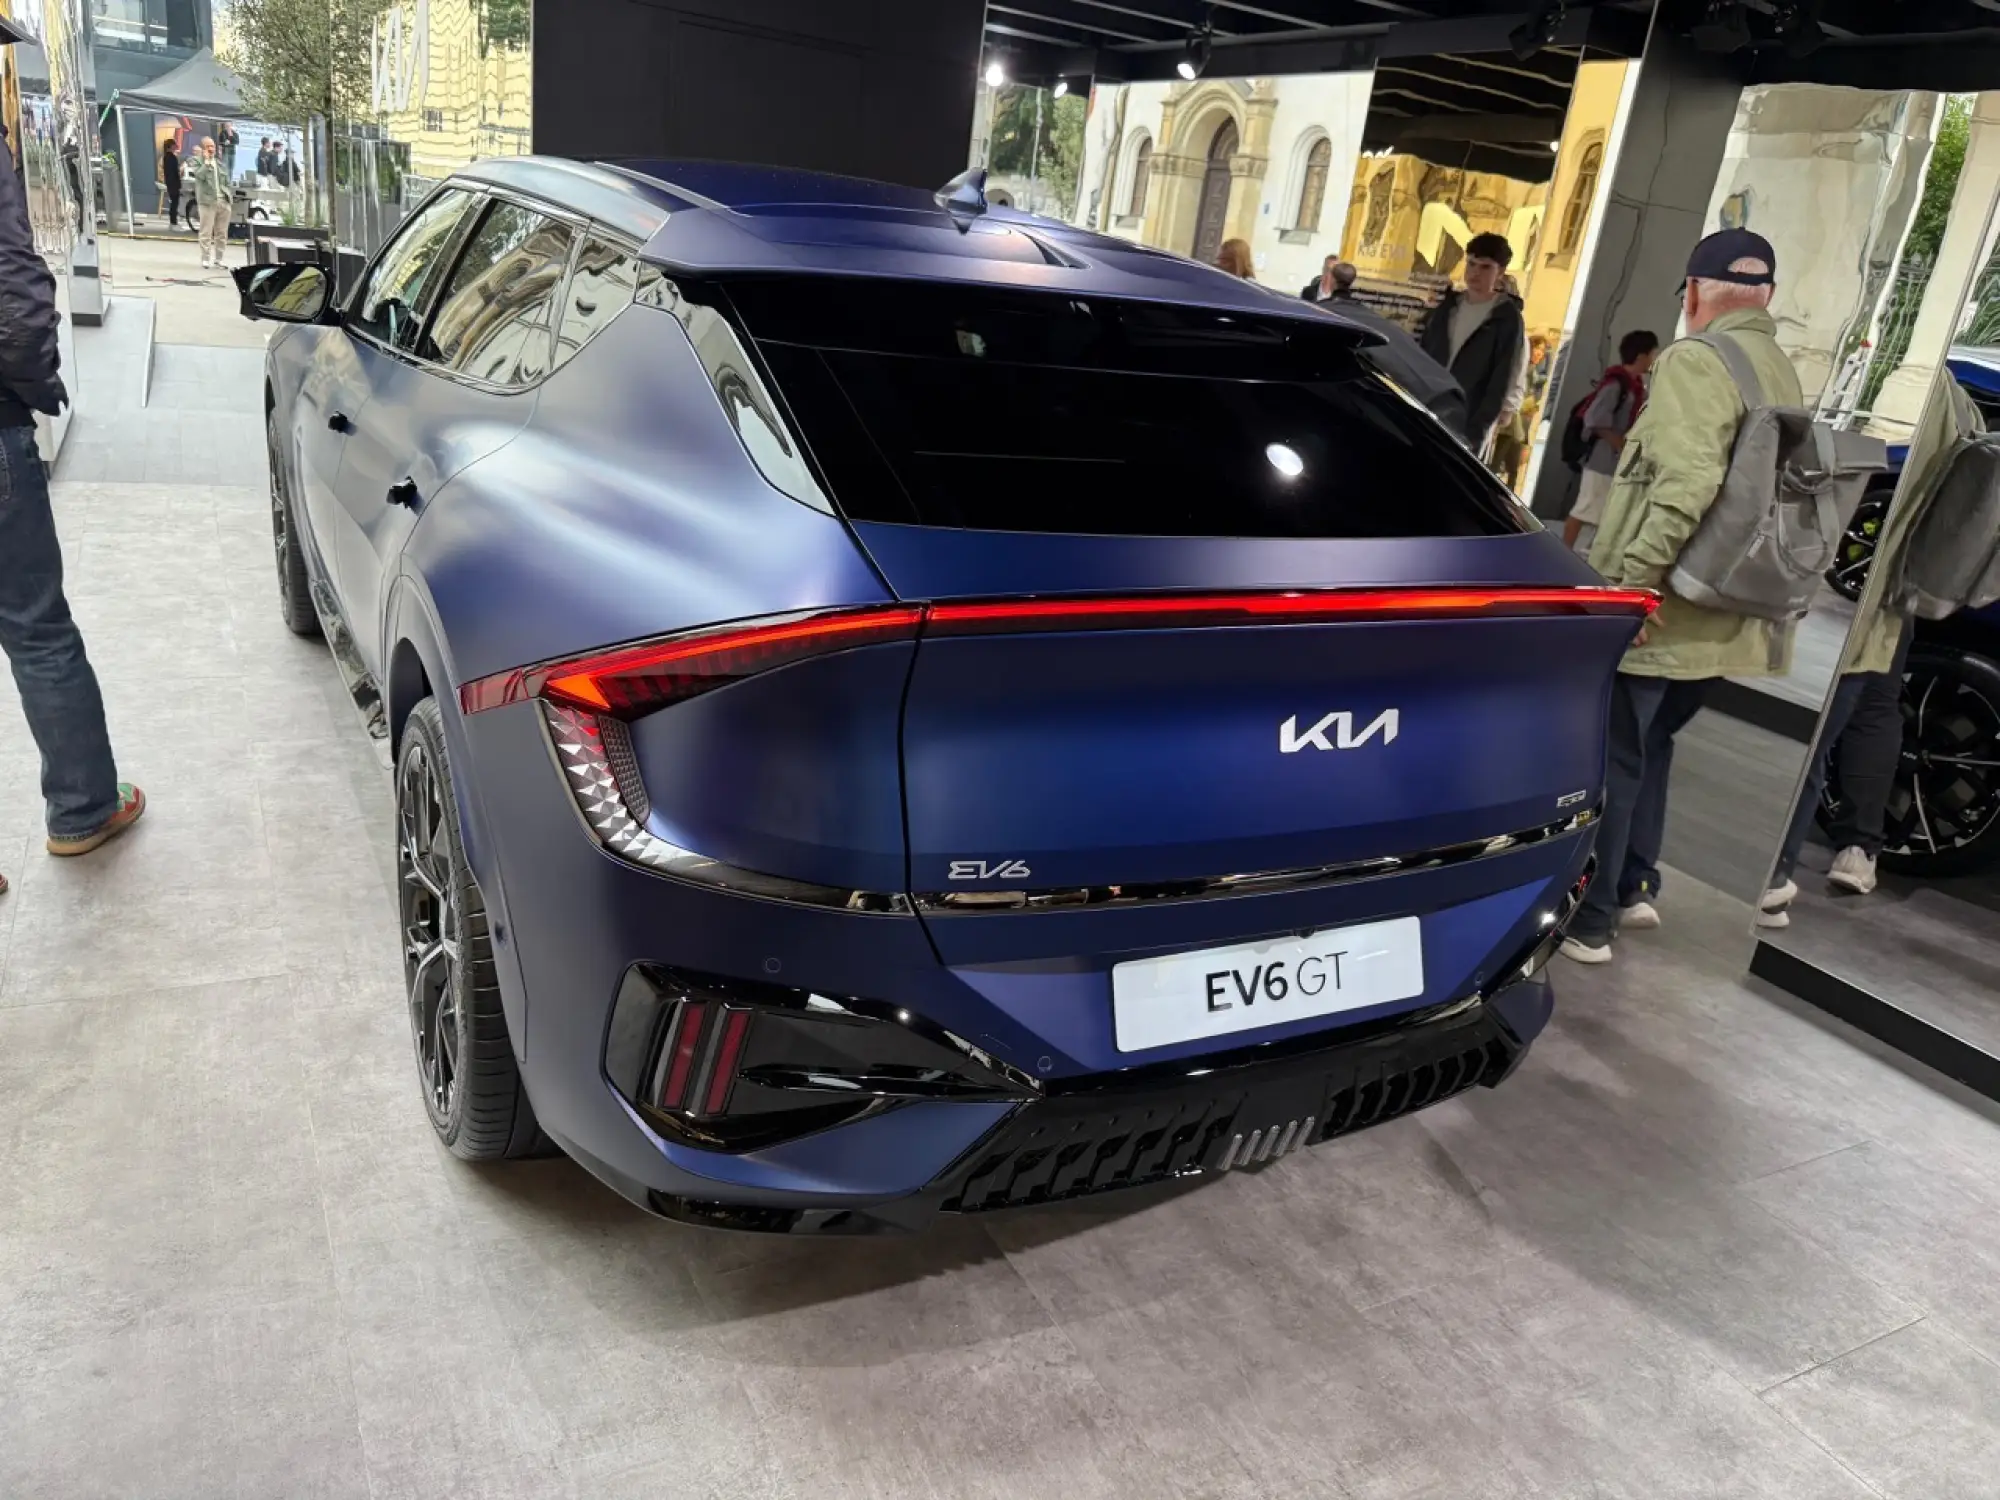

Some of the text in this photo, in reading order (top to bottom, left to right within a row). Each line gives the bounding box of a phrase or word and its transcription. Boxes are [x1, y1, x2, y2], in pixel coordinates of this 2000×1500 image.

[1280, 708, 1399, 753] KIA
[947, 860, 1031, 880] EV6
[1205, 950, 1349, 1013] EV6 GT
